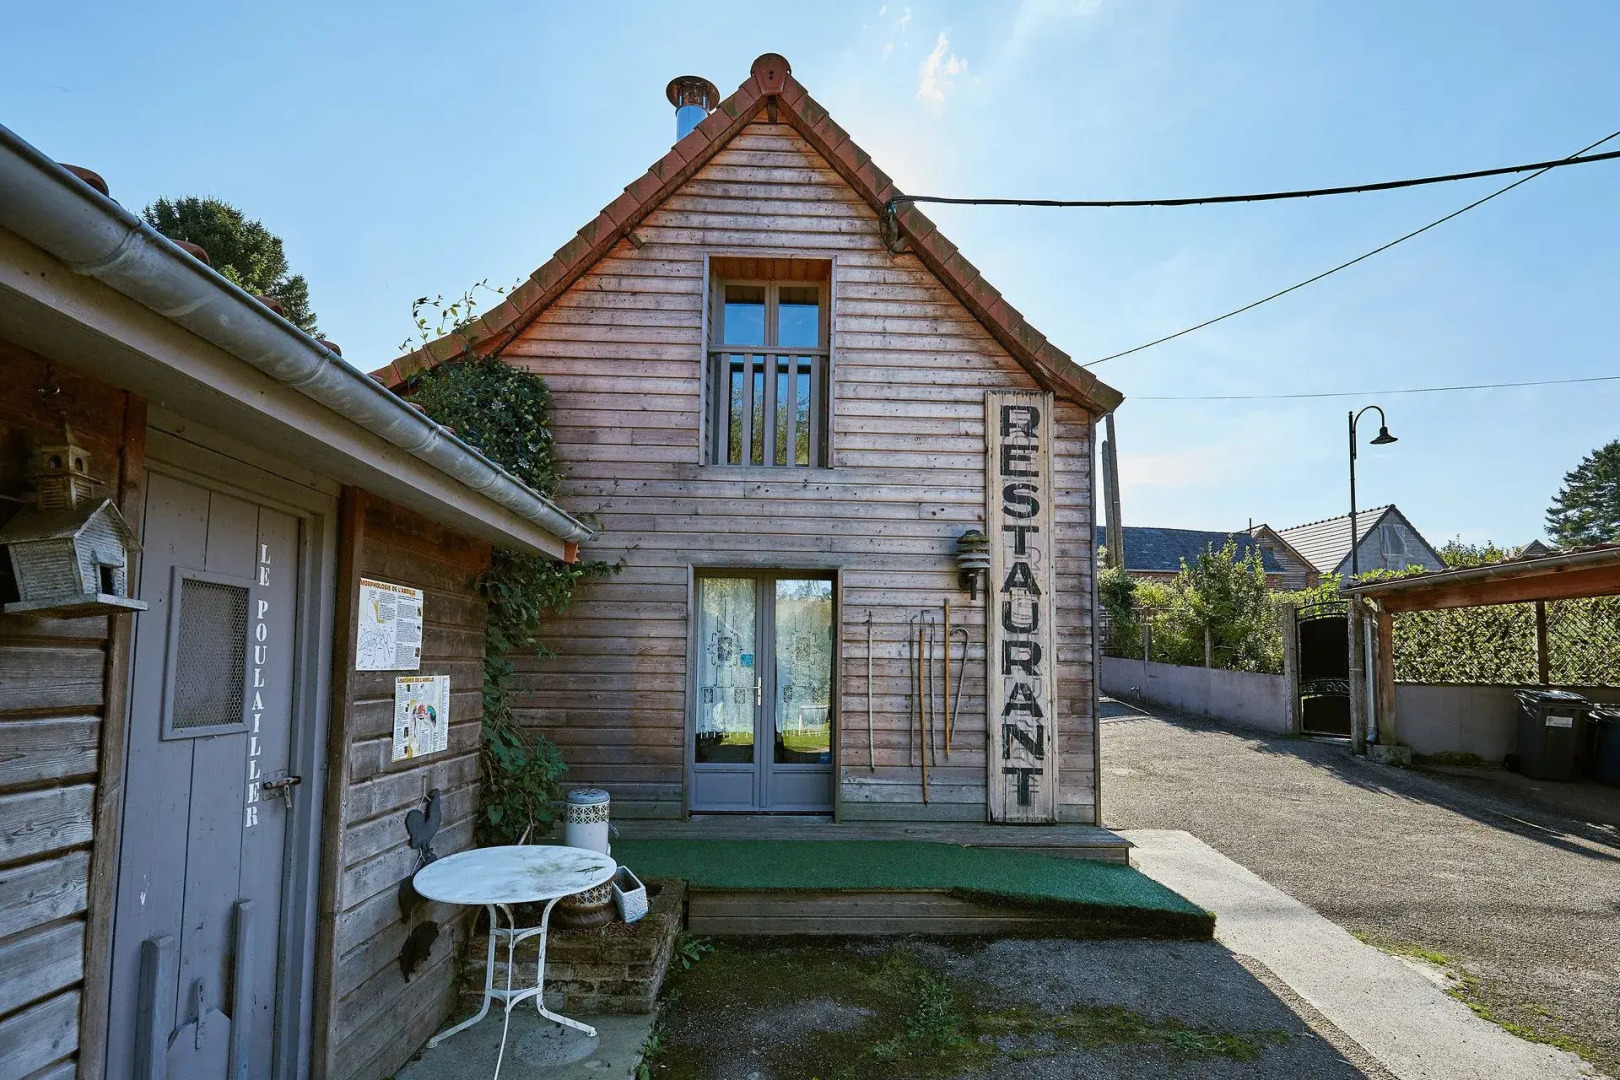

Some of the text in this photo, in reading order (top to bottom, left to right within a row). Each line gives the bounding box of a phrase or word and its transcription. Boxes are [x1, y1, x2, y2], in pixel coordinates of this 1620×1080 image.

[245, 543, 270, 828] LE POULAILLER
[1000, 405, 1045, 806] RESTAURANT
